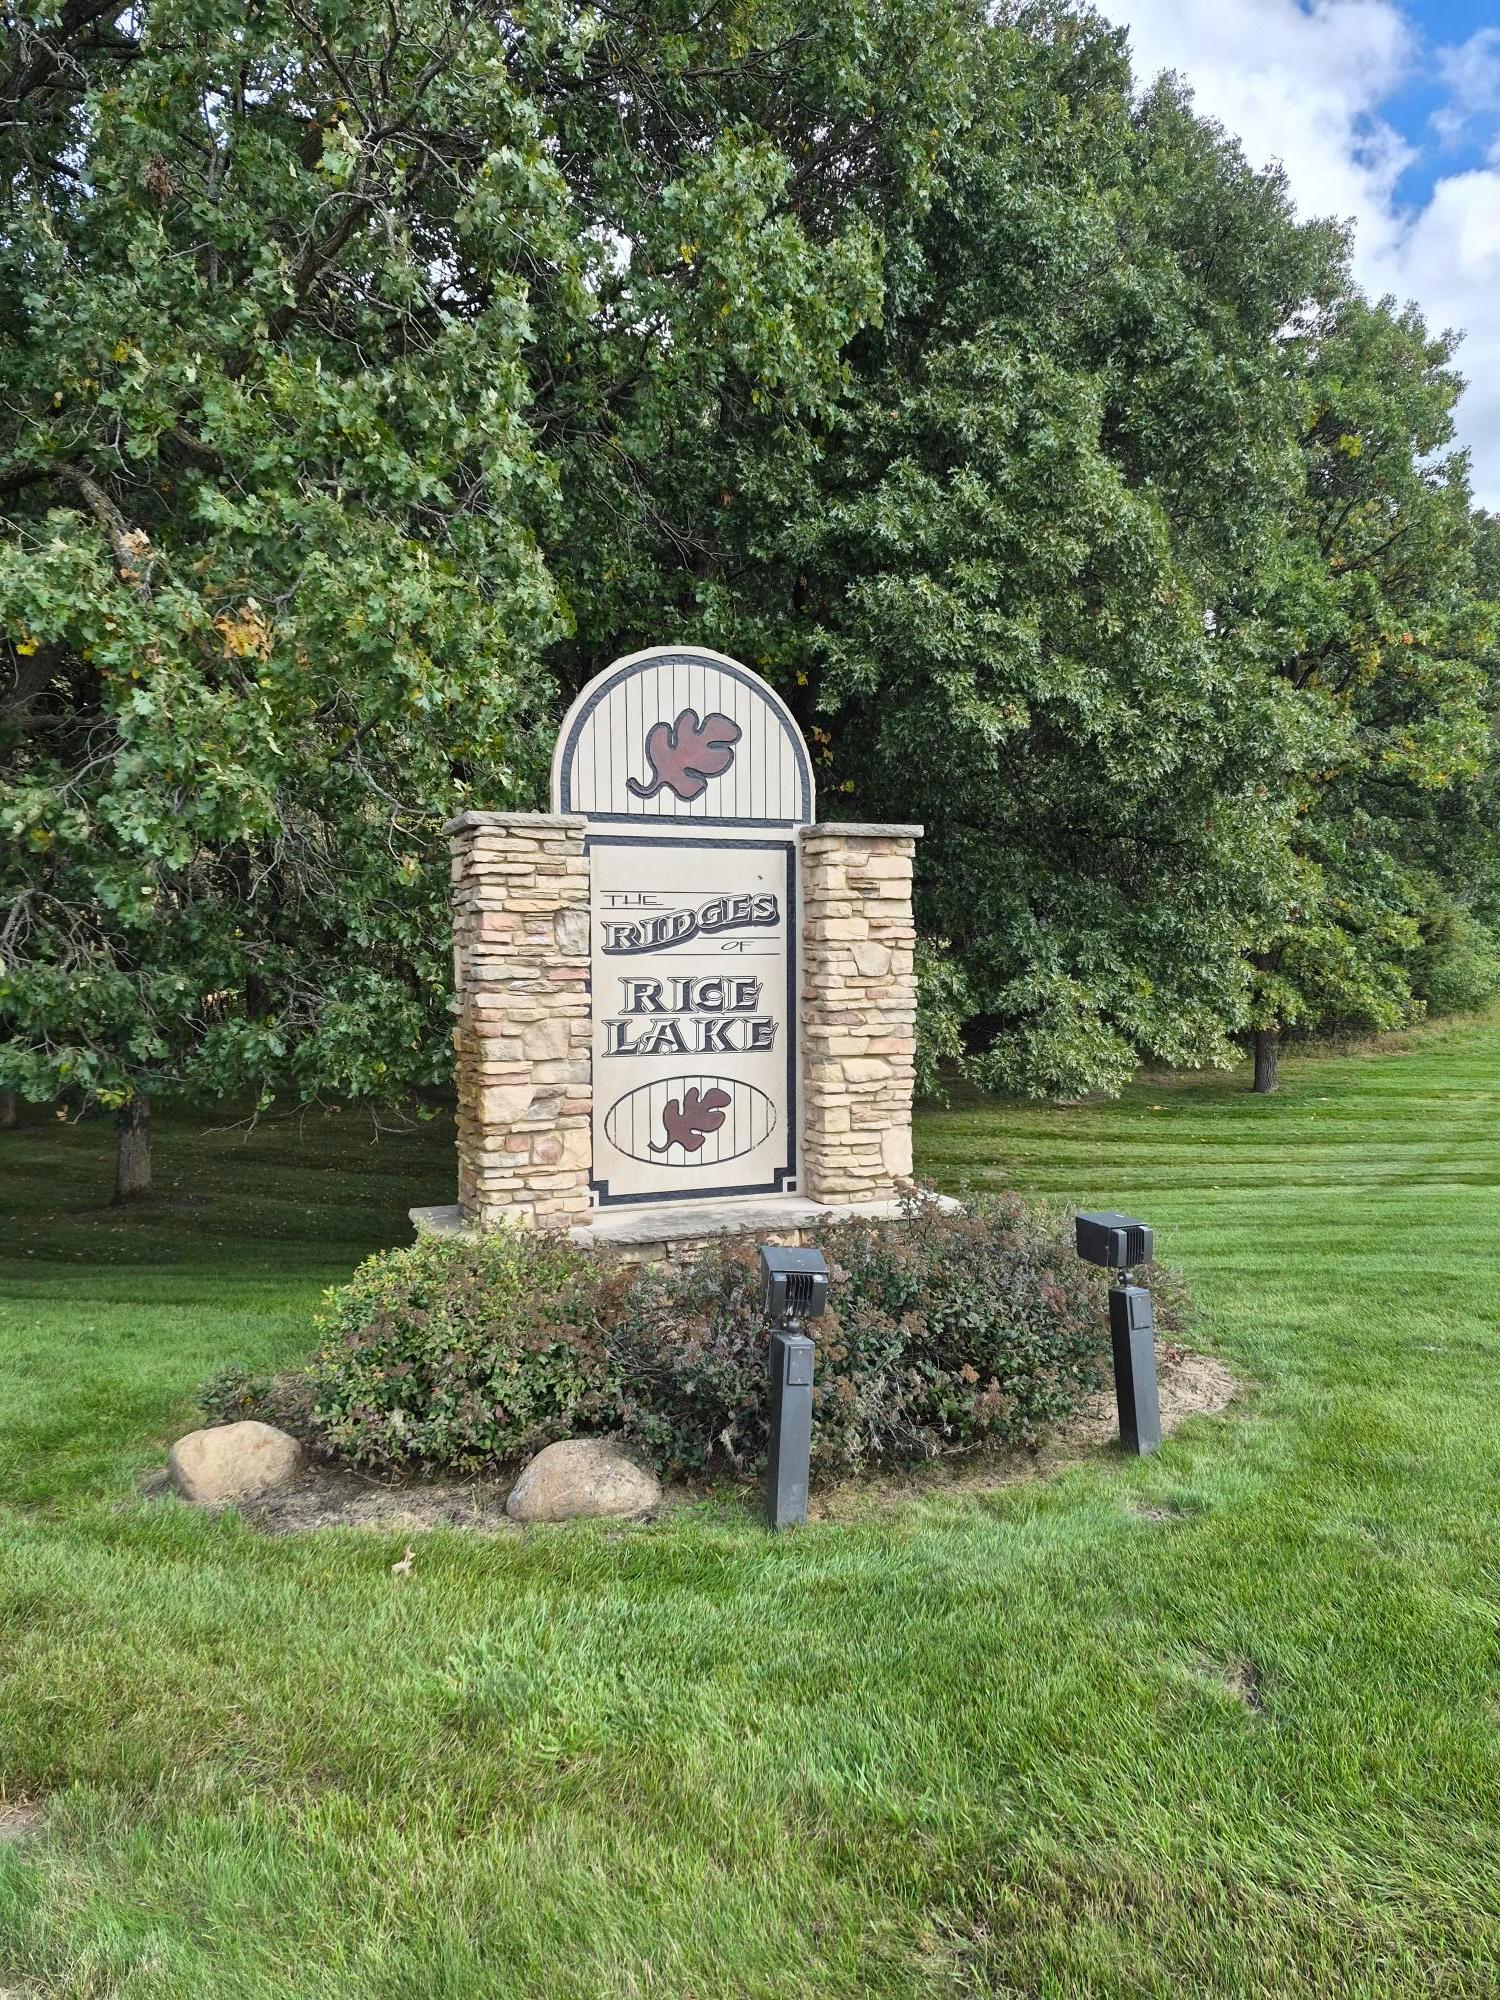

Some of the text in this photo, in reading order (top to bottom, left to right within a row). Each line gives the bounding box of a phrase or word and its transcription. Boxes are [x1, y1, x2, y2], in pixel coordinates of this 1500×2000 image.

[603, 893, 664, 907] THE
[600, 893, 780, 955] RIDGES
[720, 941, 756, 953] OF
[618, 976, 763, 1015] RICE
[601, 1016, 779, 1057] LAKE
